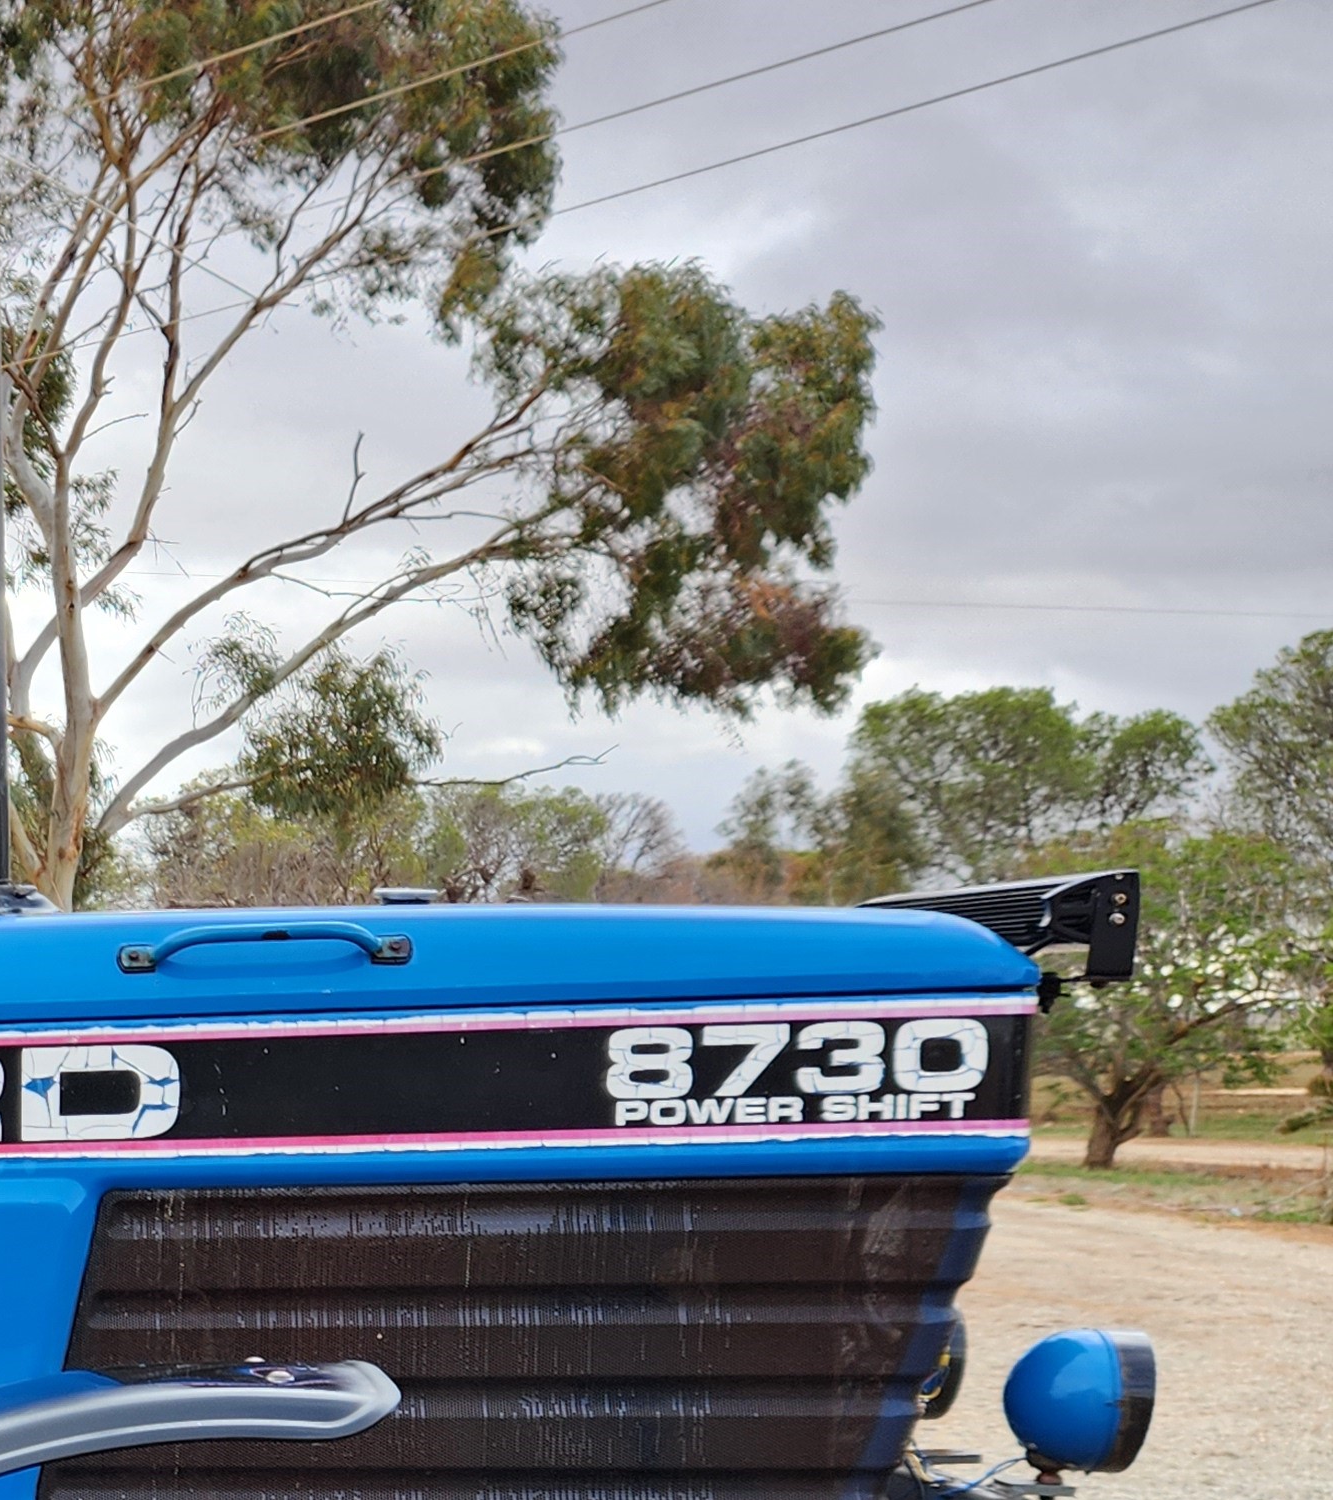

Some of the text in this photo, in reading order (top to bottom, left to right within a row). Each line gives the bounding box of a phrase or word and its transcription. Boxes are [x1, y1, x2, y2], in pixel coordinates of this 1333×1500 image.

[606, 1018, 989, 1099] 8730
[615, 1092, 976, 1126] POWER SHIFT
